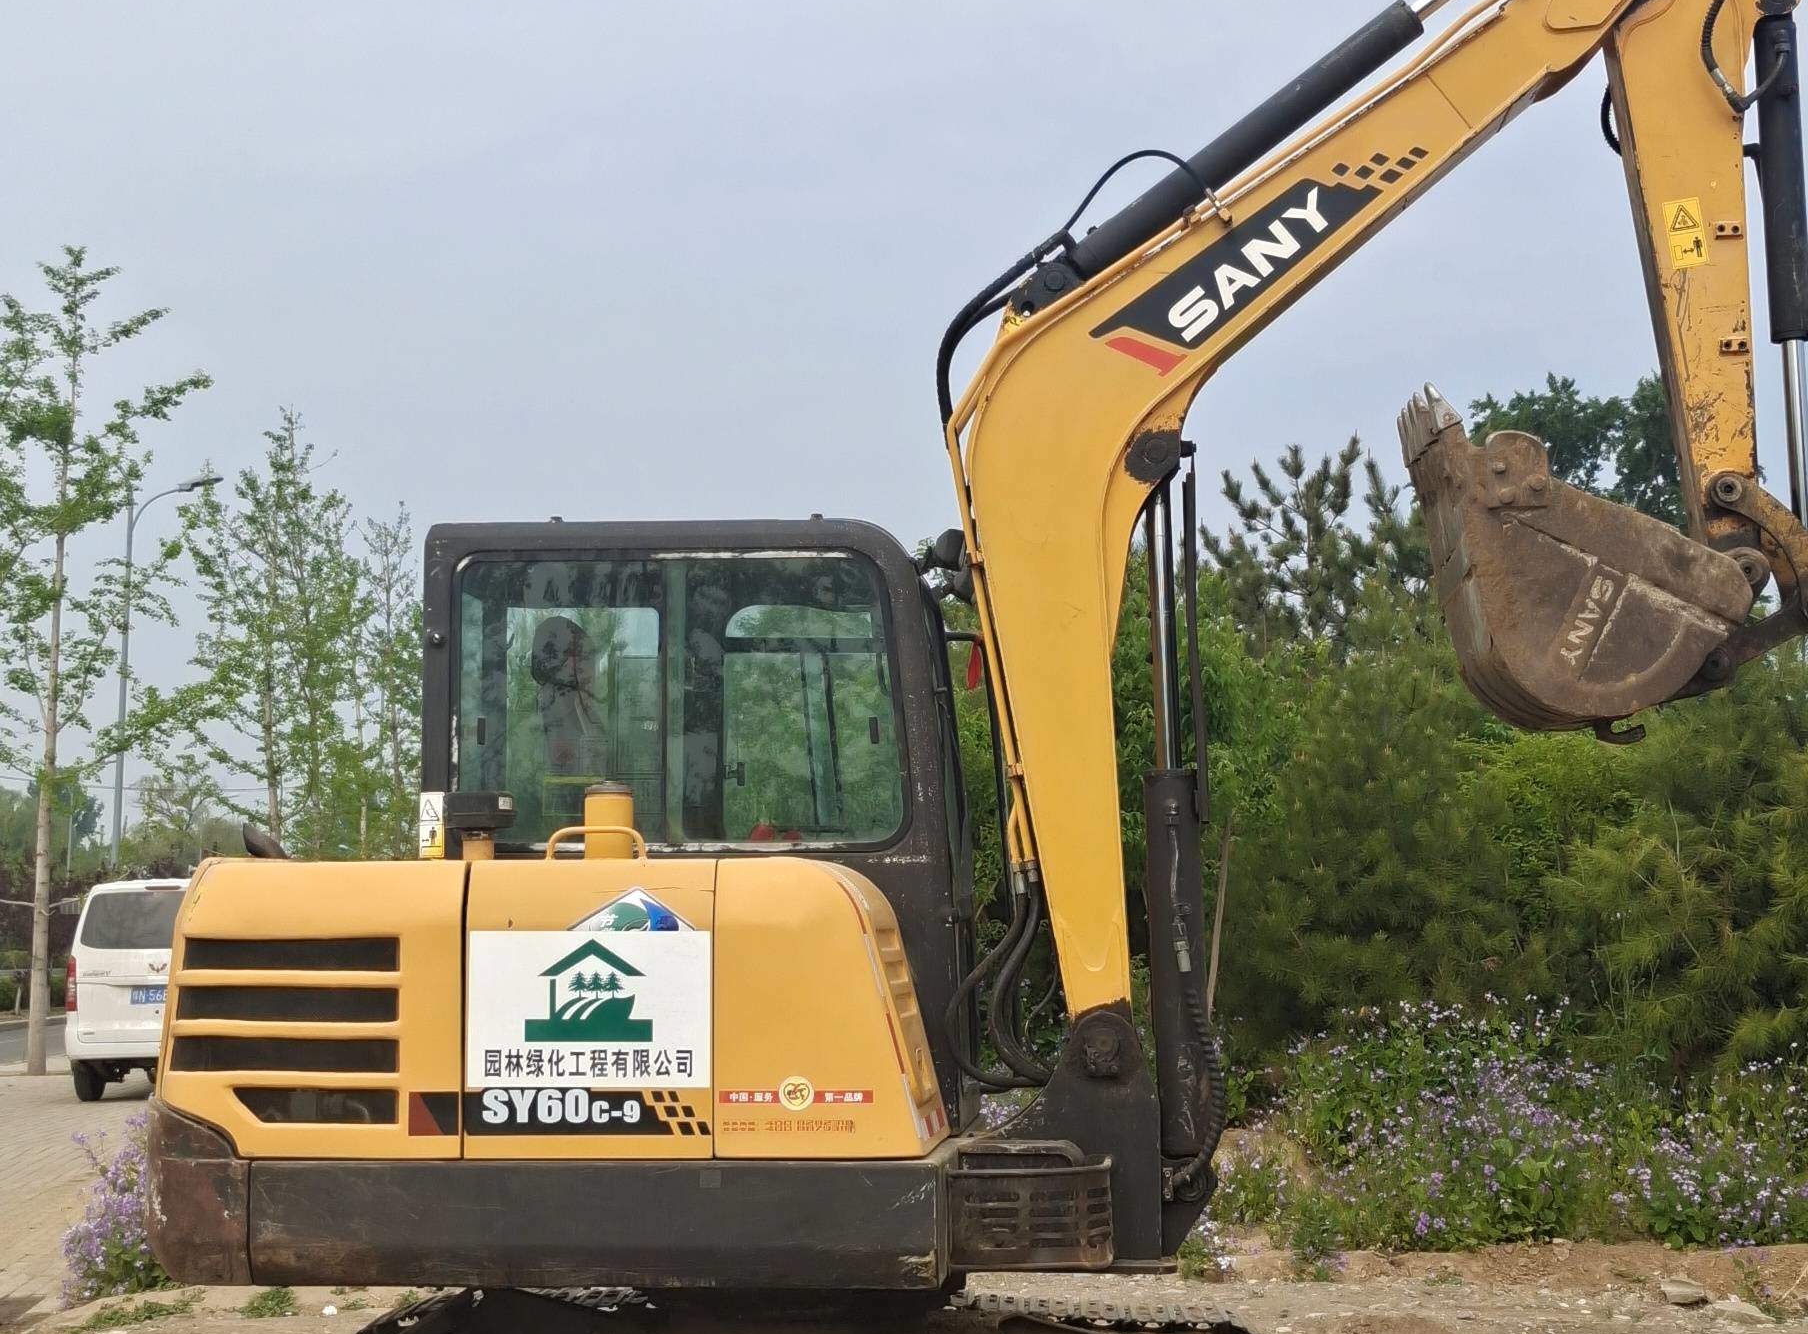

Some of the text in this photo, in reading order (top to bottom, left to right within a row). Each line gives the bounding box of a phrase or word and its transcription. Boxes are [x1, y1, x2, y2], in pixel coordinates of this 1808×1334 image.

[1168, 186, 1330, 343] SANY
[1560, 575, 1614, 666] SANY
[484, 1048, 694, 1078] 园林绿化工程有限公司
